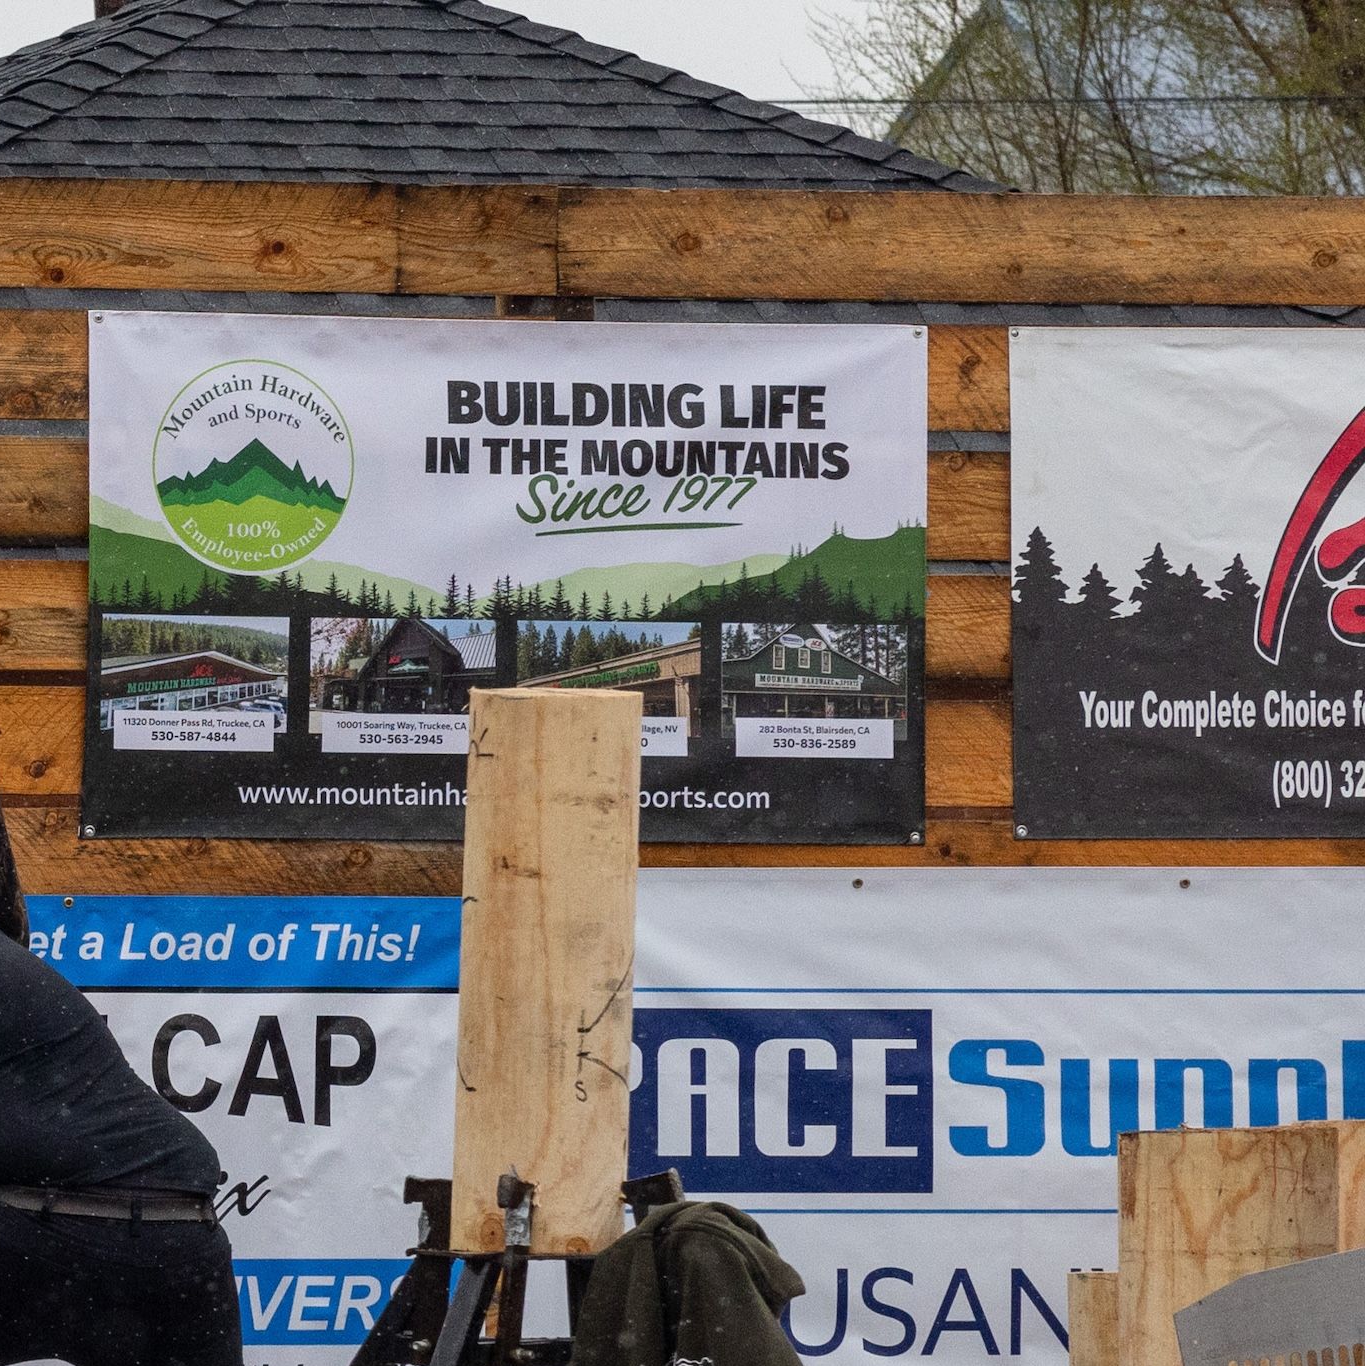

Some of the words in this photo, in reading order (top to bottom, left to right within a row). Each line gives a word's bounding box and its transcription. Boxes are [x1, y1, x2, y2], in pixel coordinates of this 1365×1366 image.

[162, 374, 253, 440] Mountain
[259, 375, 346, 444] Hardware
[207, 404, 239, 428] and
[244, 403, 302, 430] Sports
[446, 379, 705, 430] BUILDING
[719, 383, 827, 430] LIFE
[424, 436, 470, 475] IN
[482, 437, 569, 477] THE
[580, 439, 851, 481] MOUNTAINS
[515, 473, 651, 525] Since
[662, 475, 759, 514] 1977
[180, 516, 327, 565] Employee-Owned
[226, 520, 281, 539] 100%
[122, 718, 148, 727] 11320
[149, 718, 180, 727] Donner
[181, 719, 201, 728] Pass
[202, 719, 215, 729] Rd,
[217, 719, 251, 729] Truckee,
[252, 720, 266, 728] CA
[336, 721, 362, 729] 10001
[364, 721, 395, 731] Soaring
[396, 721, 417, 731] Way,
[419, 722, 453, 731] Truckee,
[454, 722, 467, 730] CA
[664, 725, 678, 733] NV
[1079, 690, 1135, 729] Your
[1142, 690, 1257, 737] Complete
[1264, 689, 1347, 728] Choice
[151, 731, 237, 742] 530-587-4844
[359, 734, 444, 745] 530-563-2945
[759, 725, 776, 734] 282
[777, 726, 802, 735] Bonta
[816, 726, 856, 736] Blairsden,
[857, 726, 870, 735] CA
[772, 738, 857, 749] 530-836-2589
[1273, 760, 1333, 808] (800)
[29, 923, 67, 960] et
[79, 931, 105, 961] a
[119, 922, 237, 961] Load
[248, 923, 300, 962] of
[310, 923, 421, 963] This!
[151, 1012, 377, 1127] CAP
